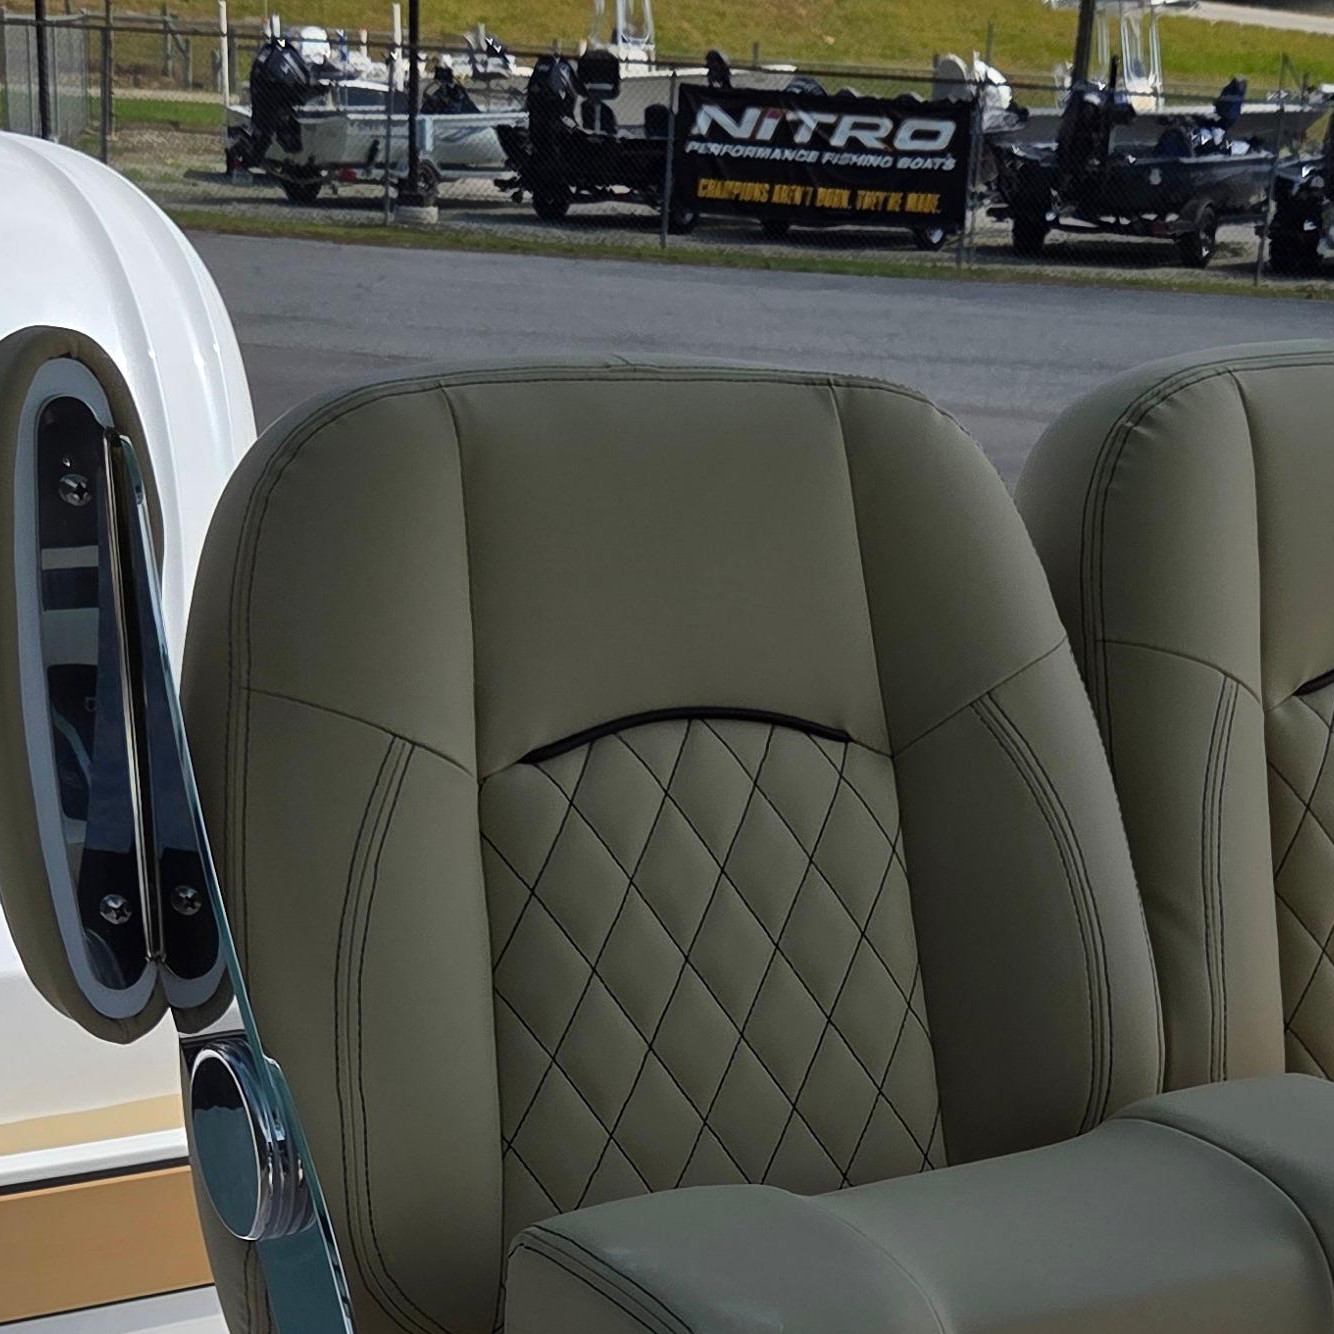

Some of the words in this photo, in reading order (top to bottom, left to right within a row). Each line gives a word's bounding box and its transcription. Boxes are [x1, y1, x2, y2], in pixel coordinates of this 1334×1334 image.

[685, 141, 819, 163] PERFORMANCE
[821, 151, 894, 168] FISHING
[896, 154, 956, 171] BOATS
[698, 178, 769, 203] CHAMPIONS
